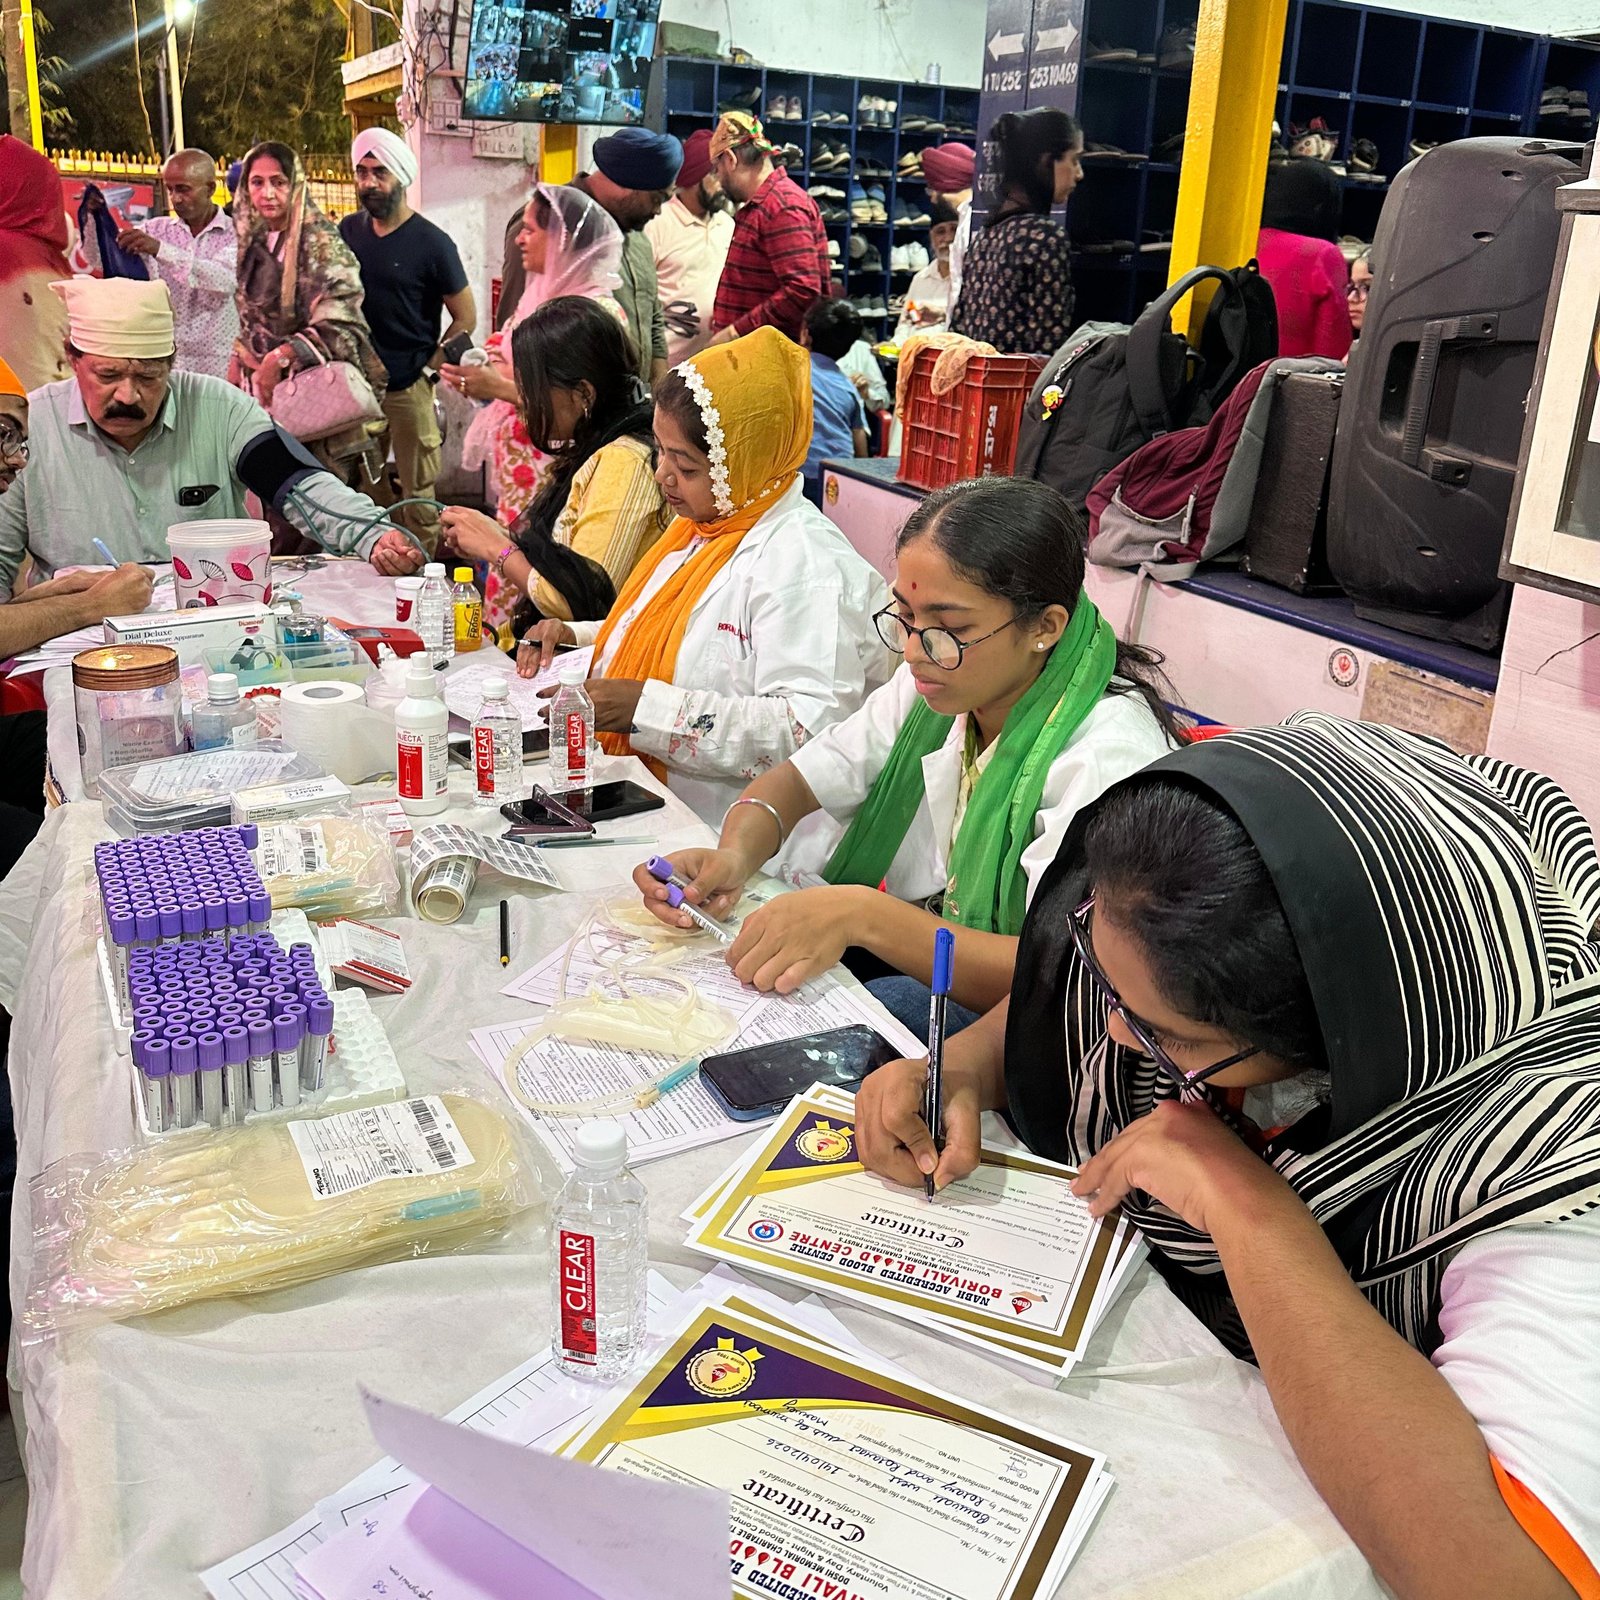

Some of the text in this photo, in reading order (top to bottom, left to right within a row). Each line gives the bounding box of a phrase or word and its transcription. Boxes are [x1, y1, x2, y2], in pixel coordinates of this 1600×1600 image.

[1001, 70, 1022, 92] 252
[1029, 66, 1049, 90] 253
[124, 629, 173, 641] Dial Deluxe
[570, 714, 580, 748] CLEAR
[478, 729, 489, 770] CLEAR
[877, 1208, 903, 1217] awarded
[814, 1225, 838, 1233] Centre
[861, 1213, 964, 1248] Certificate
[927, 1221, 957, 1233] Certificate
[789, 1231, 852, 1256] CENTRE
[838, 1231, 880, 1245] Component
[881, 1243, 903, 1252] Blood
[838, 1237, 959, 1274] DOSHI MEMORIAL CHARITABLE TRUST'S
[908, 1251, 928, 1260] Night
[937, 1258, 952, 1266] Day
[566, 1237, 587, 1311] CLEAR
[790, 1243, 990, 1306] NABH ACCREDITED BLOOD CENTRE
[923, 1269, 1002, 1299] BORIVALI
[856, 1434, 888, 1448] appreciated
[767, 1438, 842, 1474] 14/04/2026
[887, 1445, 904, 1456] highly
[910, 1455, 926, 1464] cause
[925, 1461, 940, 1470] noble
[947, 1455, 961, 1463] UNIT
[765, 1473, 796, 1488] awarded
[855, 1475, 872, 1486] Bank
[904, 1468, 934, 1484] and
[957, 1475, 991, 1491] contribution
[796, 1485, 812, 1496] been
[870, 1483, 888, 1494] Blood
[998, 1476, 1040, 1495] BLOOD GROUP
[811, 1492, 825, 1502] has
[888, 1490, 900, 1498] this
[991, 1489, 1019, 1503] impressive
[743, 1479, 865, 1542] Certificate
[824, 1498, 861, 1517] Certificate
[907, 1498, 933, 1512] Donation
[1017, 1500, 1032, 1510] This
[860, 1513, 875, 1525] This
[931, 1509, 950, 1520] Blood
[998, 1507, 1028, 1523] Organised
[951, 1516, 979, 1533] Voluntary
[1003, 1522, 1021, 1535] Camp
[758, 1528, 785, 1544] Blood
[979, 1530, 990, 1538] her
[993, 1535, 1004, 1544] his
[791, 1543, 815, 1557] Night
[1003, 1540, 1015, 1548] for
[737, 1529, 850, 1585] DOSHI MEMORIAL CHARITABLE
[825, 1558, 844, 1570] Day
[846, 1567, 888, 1592] Voluntary,
